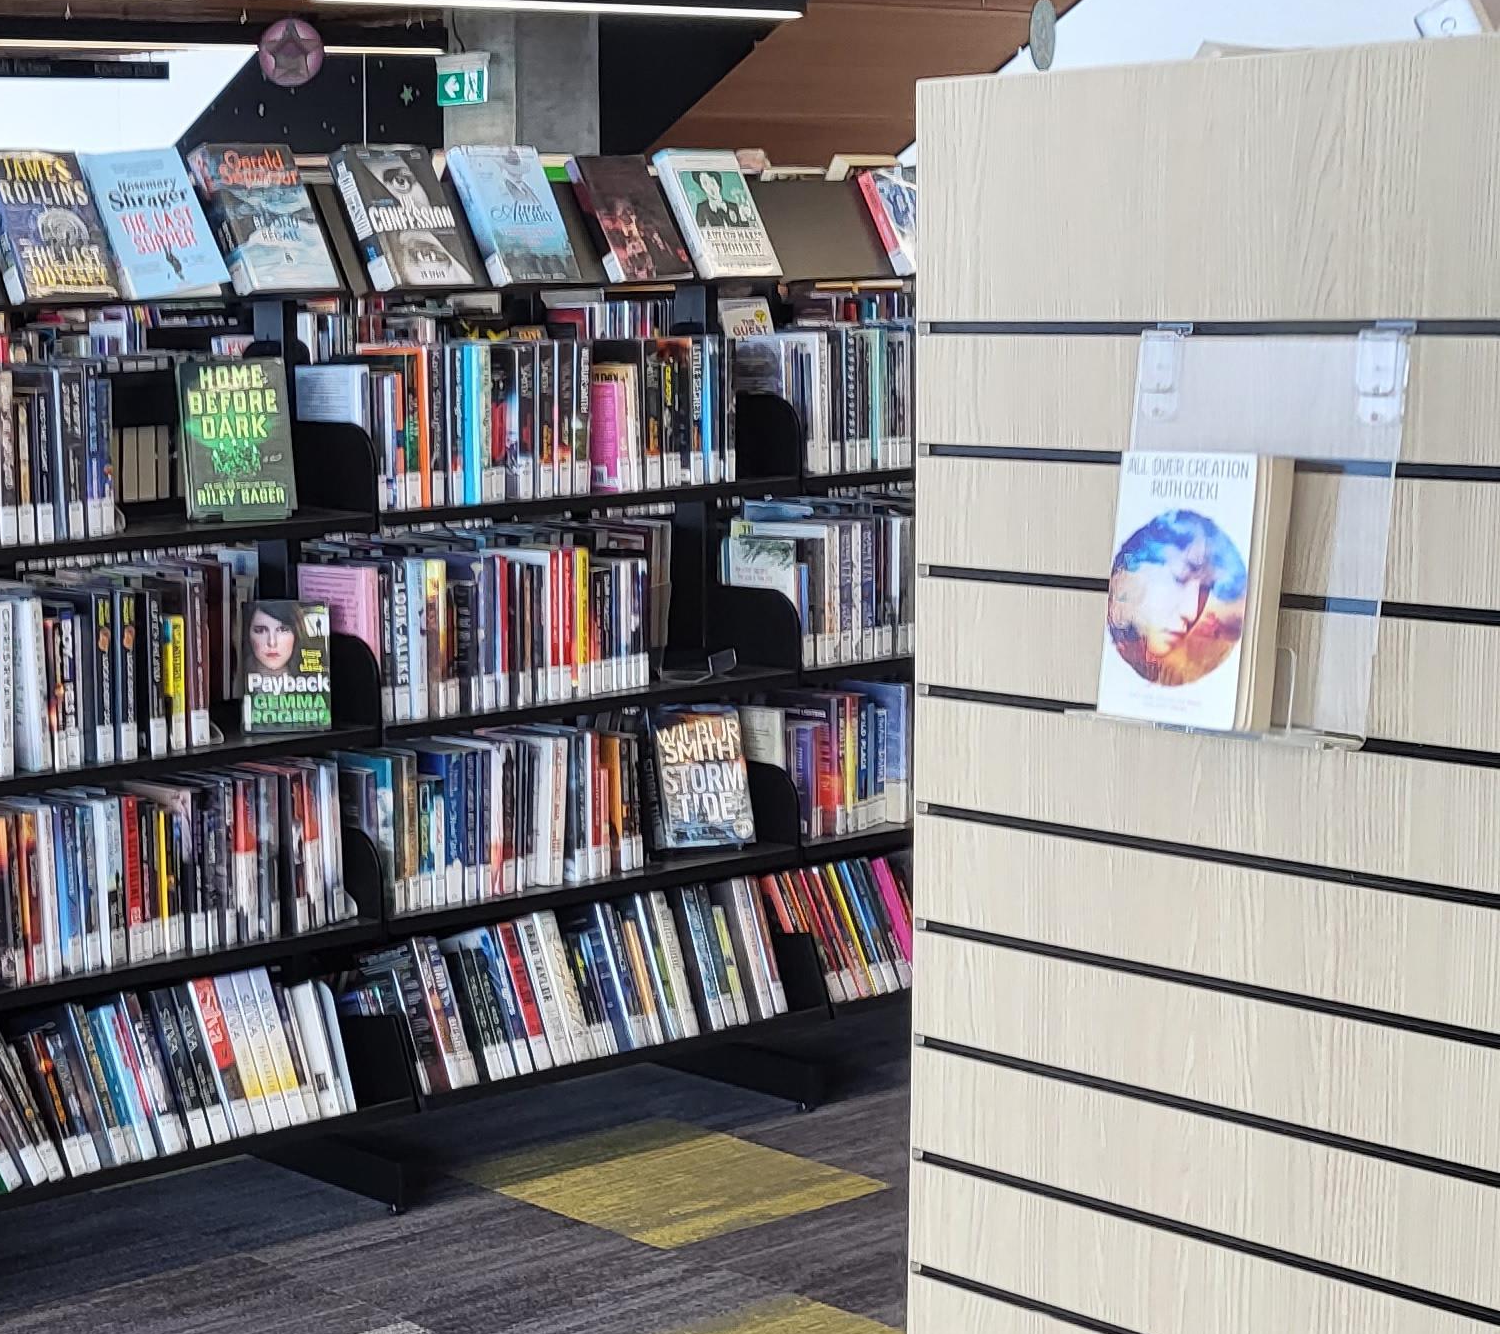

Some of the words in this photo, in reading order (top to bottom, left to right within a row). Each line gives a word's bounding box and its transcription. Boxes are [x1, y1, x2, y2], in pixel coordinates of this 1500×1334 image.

[2, 157, 72, 182] JAMES
[117, 177, 177, 194] Rosemary
[108, 188, 188, 212] Shrager
[120, 212, 149, 236] THE
[152, 206, 194, 232] LAST
[368, 205, 456, 233] CONFESSION
[132, 227, 198, 256] SUPPER
[260, 228, 301, 241] RECALL
[61, 245, 101, 267] LAST
[732, 324, 769, 338] QUEST
[199, 364, 264, 391] HOME
[187, 388, 278, 415] BEFORE
[201, 414, 268, 440] DARK
[1127, 457, 1148, 476] ALL
[1153, 457, 1185, 476] OVER
[1188, 458, 1250, 479] CREATION
[196, 487, 236, 506] RILEY
[1151, 480, 1182, 499] RUTH
[1184, 481, 1220, 501] OZEKI
[394, 582, 410, 685] LOOK-ALIKE
[247, 673, 330, 696] Payback
[253, 694, 327, 710] GEMMA
[655, 718, 741, 748] WILBUR
[663, 739, 736, 764] SMITH
[661, 762, 745, 794] STORM
[676, 791, 737, 824] TIDE
[200, 985, 223, 1044] Silva
[160, 1008, 179, 1056] SILVA
[182, 1004, 199, 1052] SILVA
